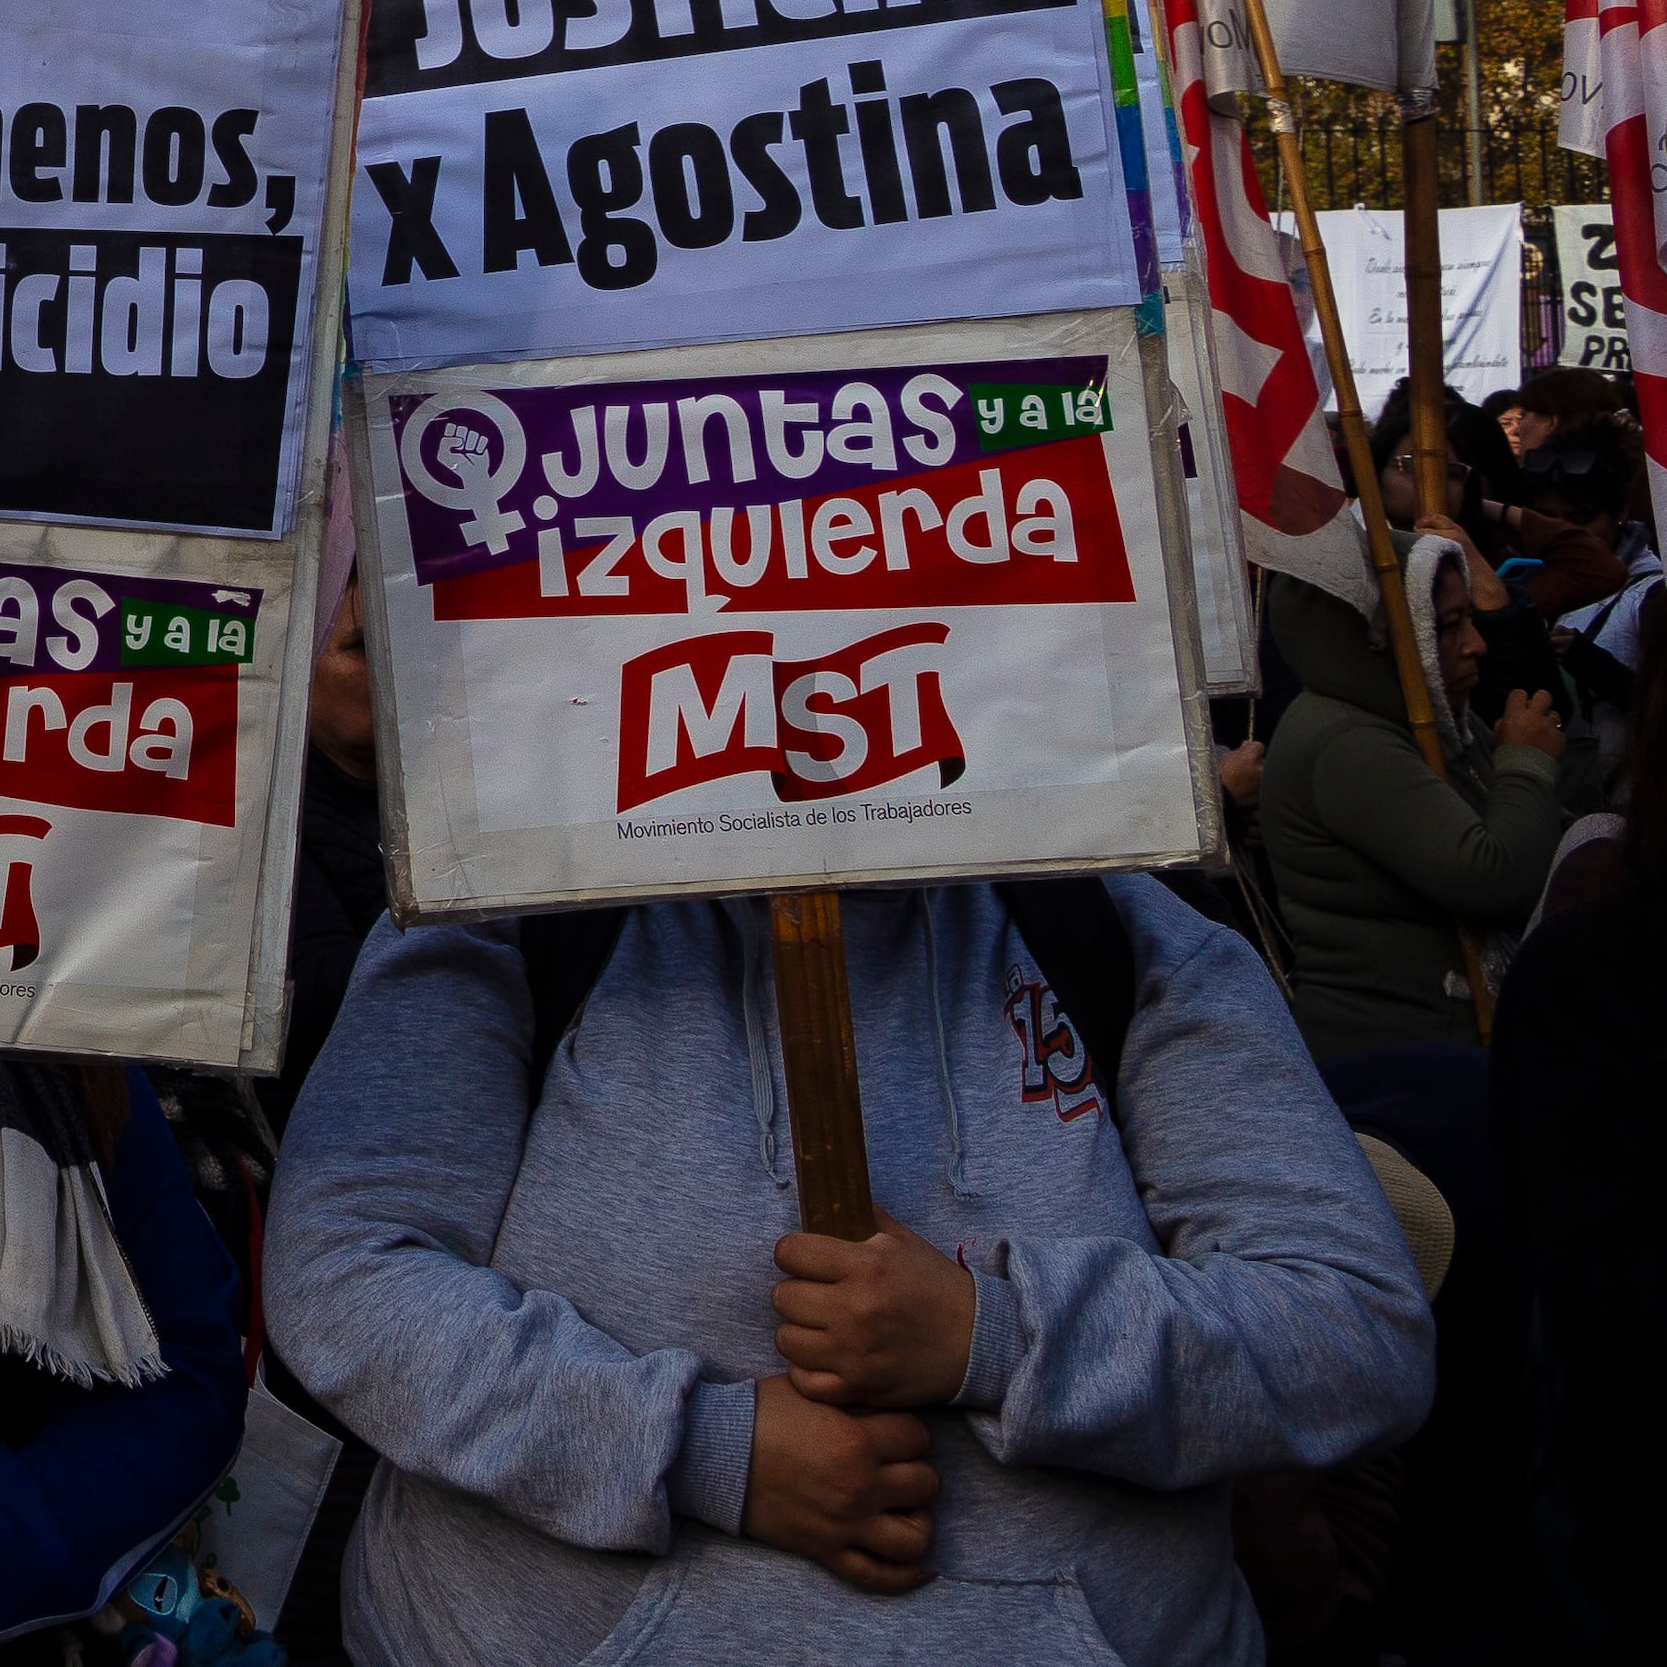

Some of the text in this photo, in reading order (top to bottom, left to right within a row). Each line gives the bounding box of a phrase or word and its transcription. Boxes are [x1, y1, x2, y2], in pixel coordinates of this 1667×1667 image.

[366, 60, 1083, 291] x Agostina
[979, 396, 1005, 436] y
[1020, 395, 1049, 431] a
[533, 469, 1079, 612] izquierda
[125, 613, 150, 653] y
[163, 617, 191, 655] a
[207, 618, 246, 658] la
[644, 632, 950, 784] MST
[616, 798, 973, 841] Movimiento Socialista de los Trabajadores
